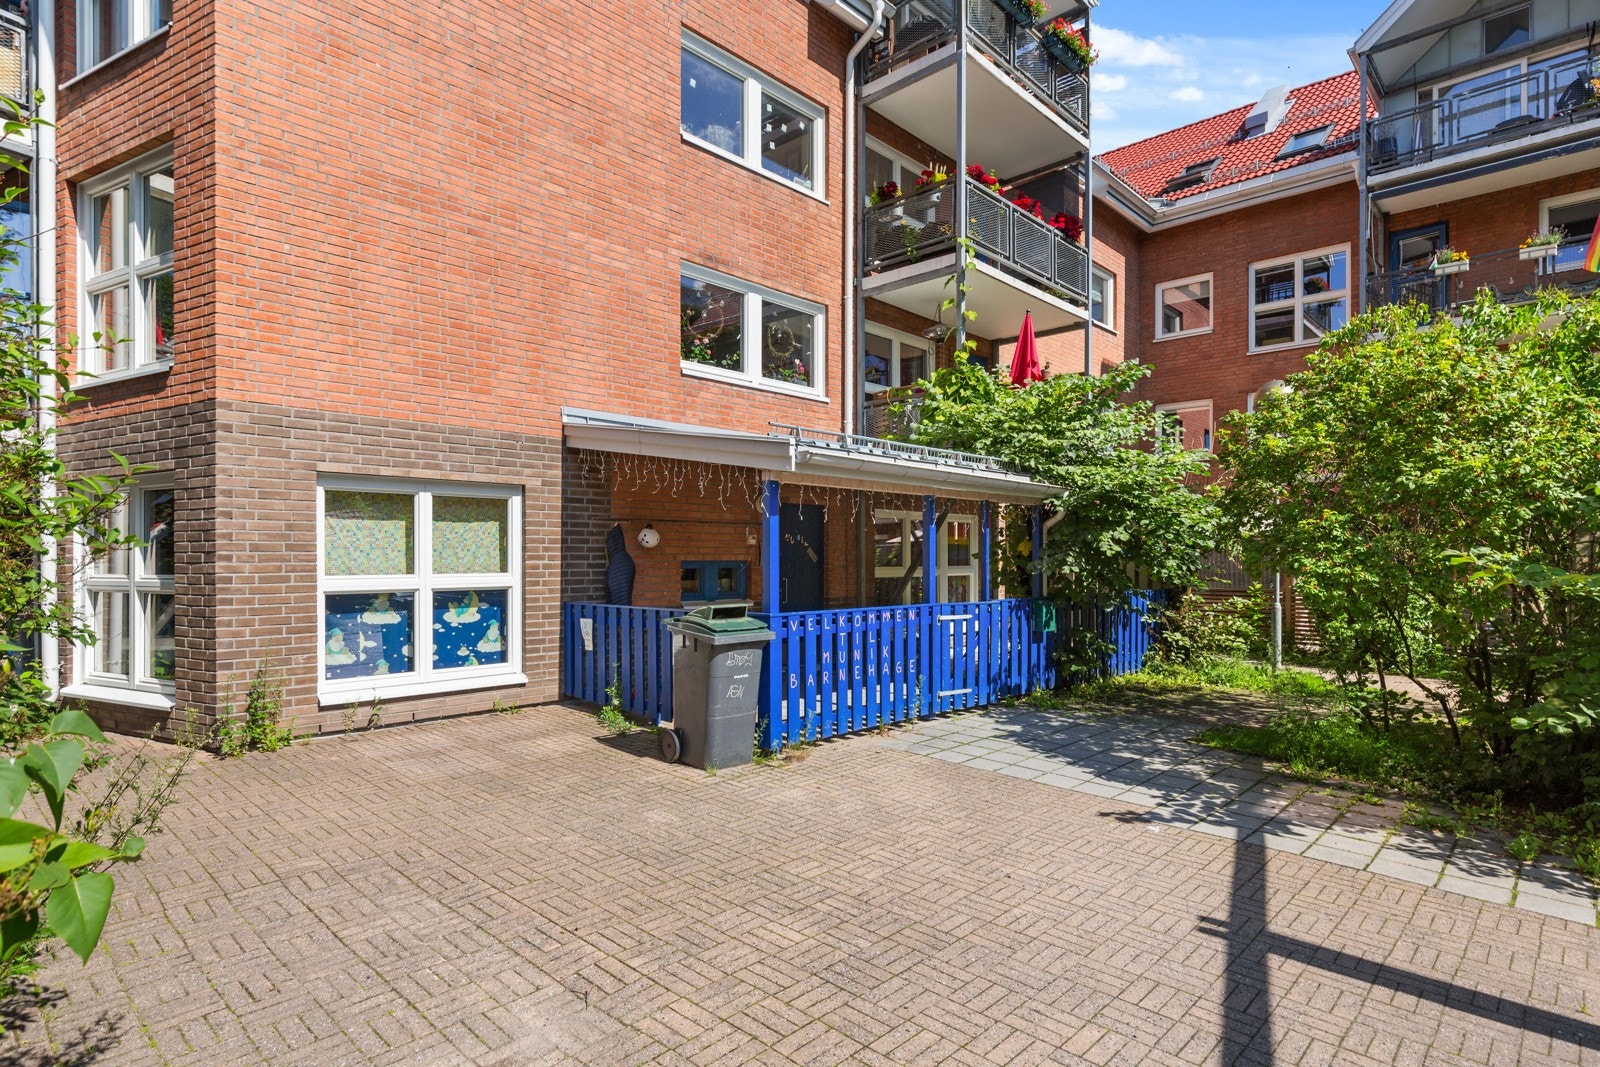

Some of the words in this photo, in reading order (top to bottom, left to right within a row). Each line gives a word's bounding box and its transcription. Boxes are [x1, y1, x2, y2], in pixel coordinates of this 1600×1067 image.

[790, 609, 915, 632] VELKOMMEN
[839, 631, 876, 646] TIL
[822, 646, 889, 664] MUNIK
[790, 659, 916, 689] BARNEHAGE
